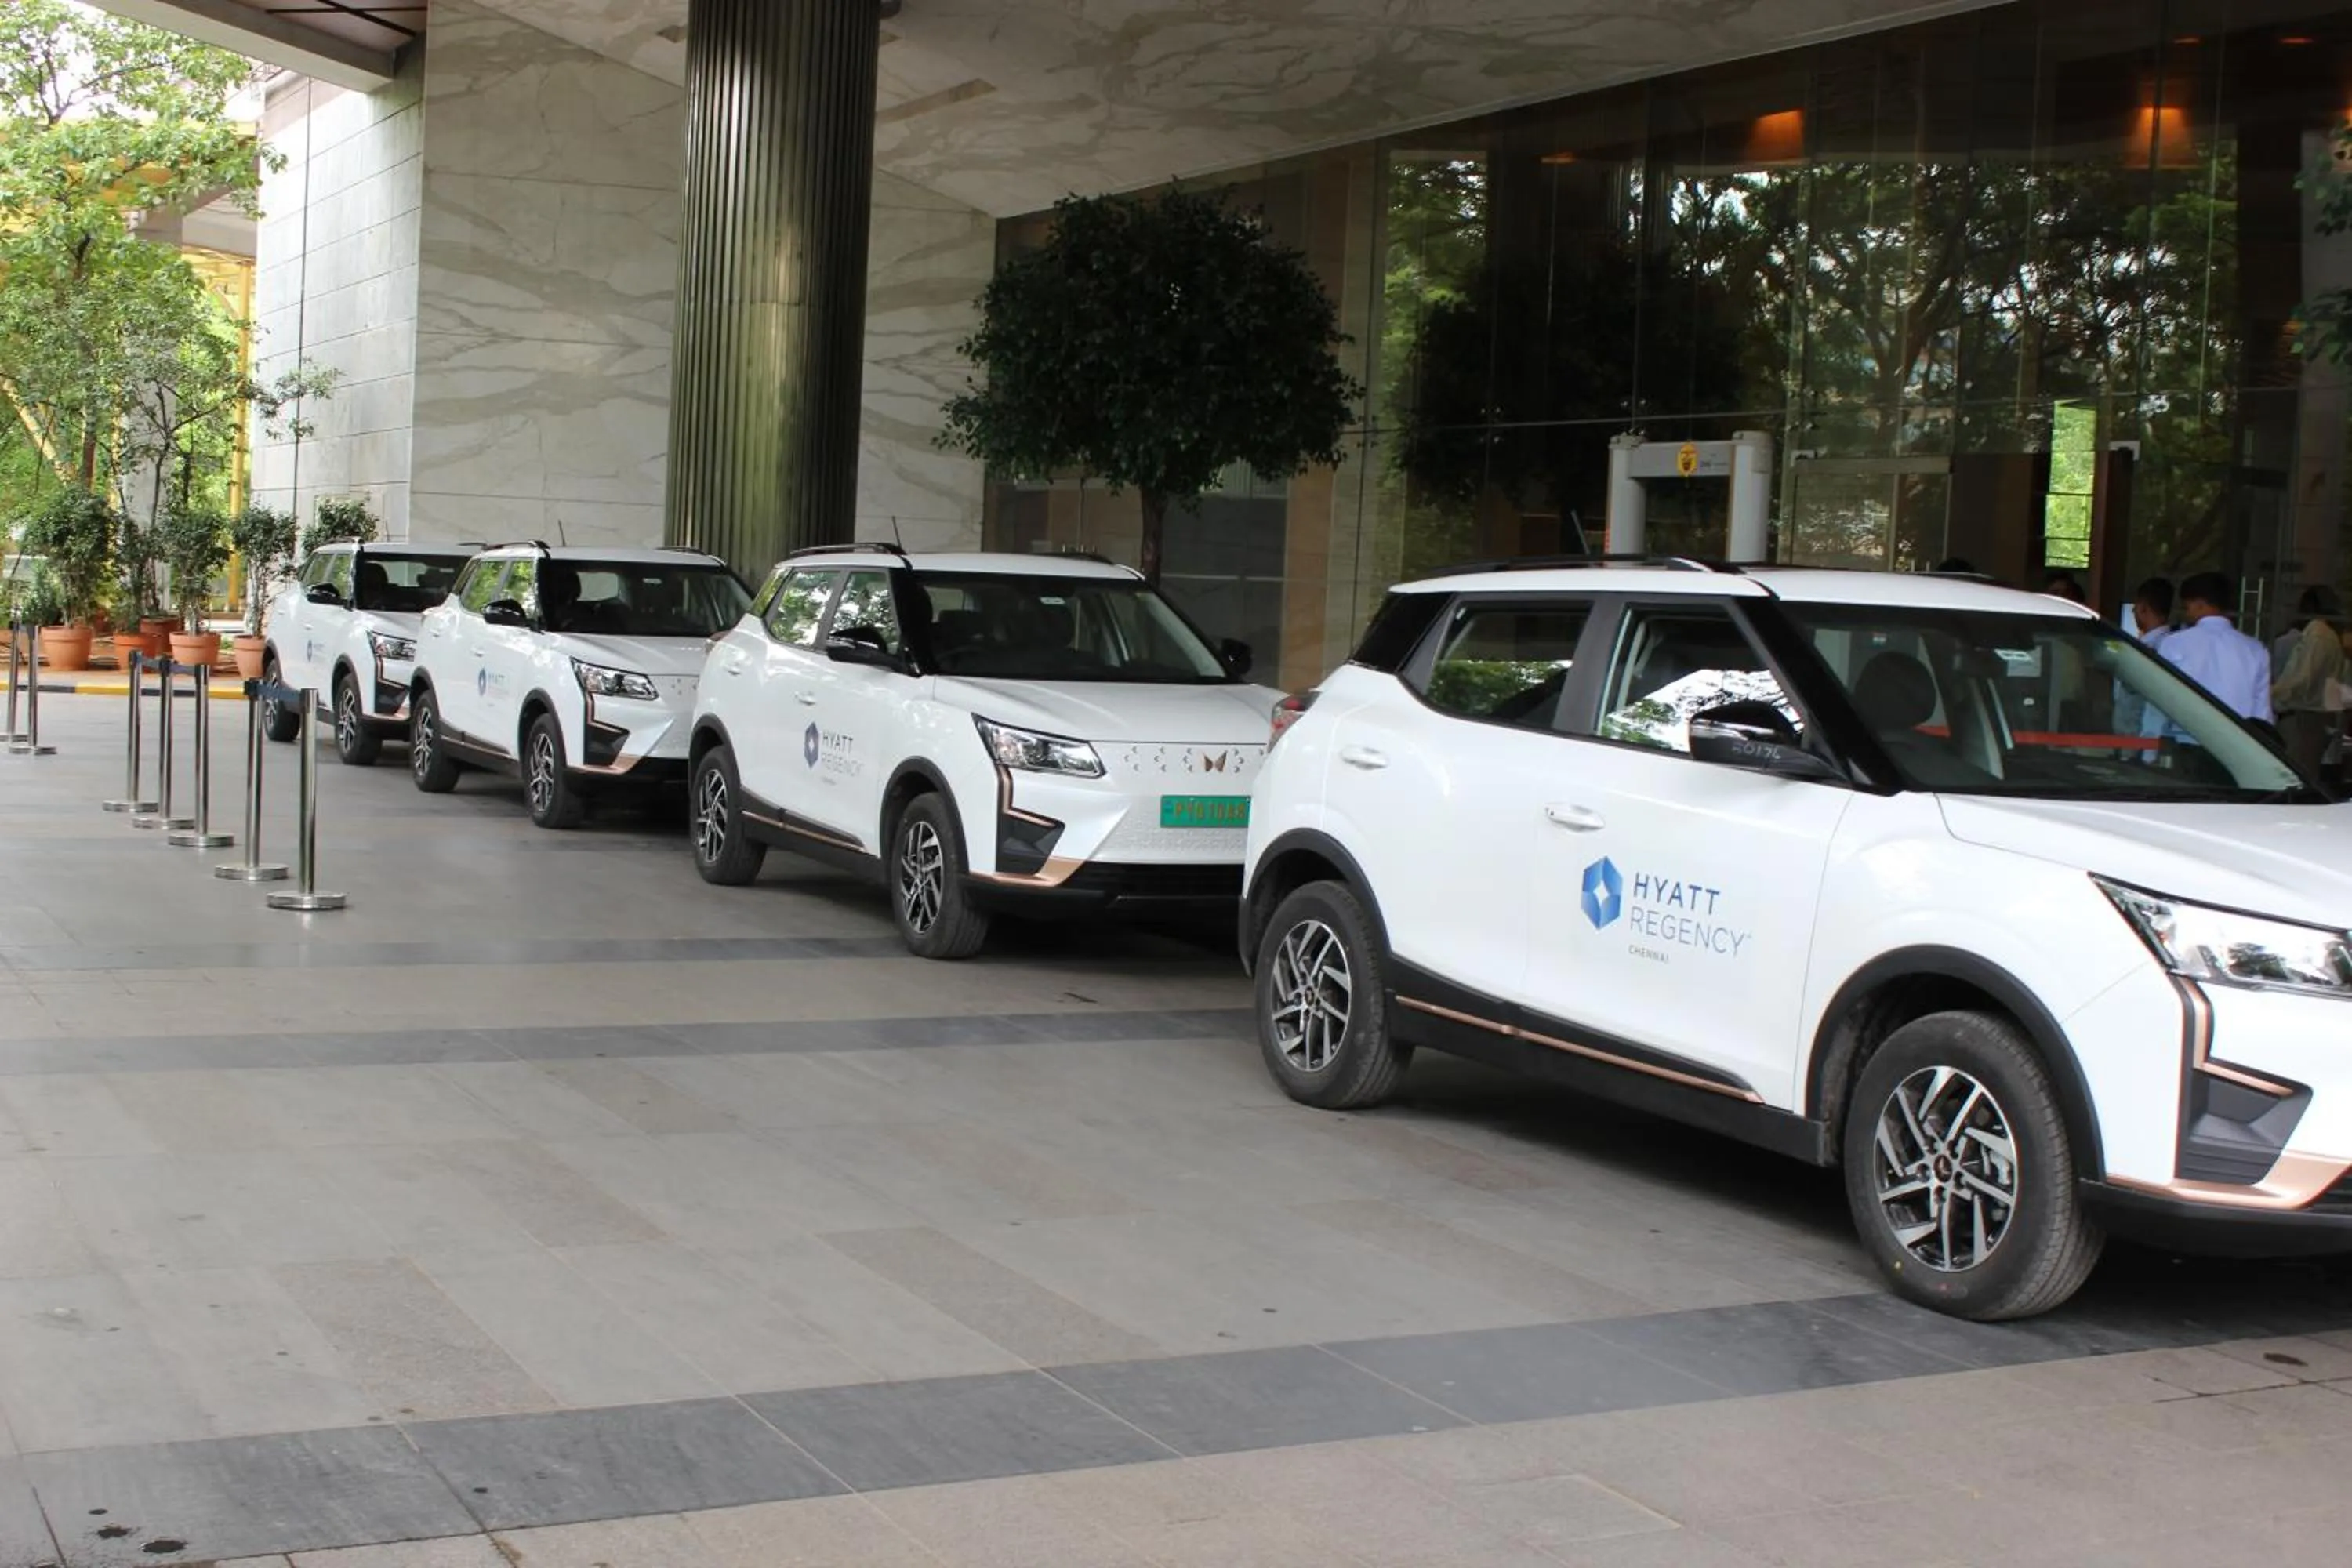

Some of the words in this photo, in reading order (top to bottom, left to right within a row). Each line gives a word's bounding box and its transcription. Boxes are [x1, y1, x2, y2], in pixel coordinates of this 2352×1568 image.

[822, 731, 854, 753] HYATT
[1632, 872, 1721, 915] HYATT
[1630, 906, 1745, 958] REGENCY
[1628, 944, 1670, 964] CHENNAI
